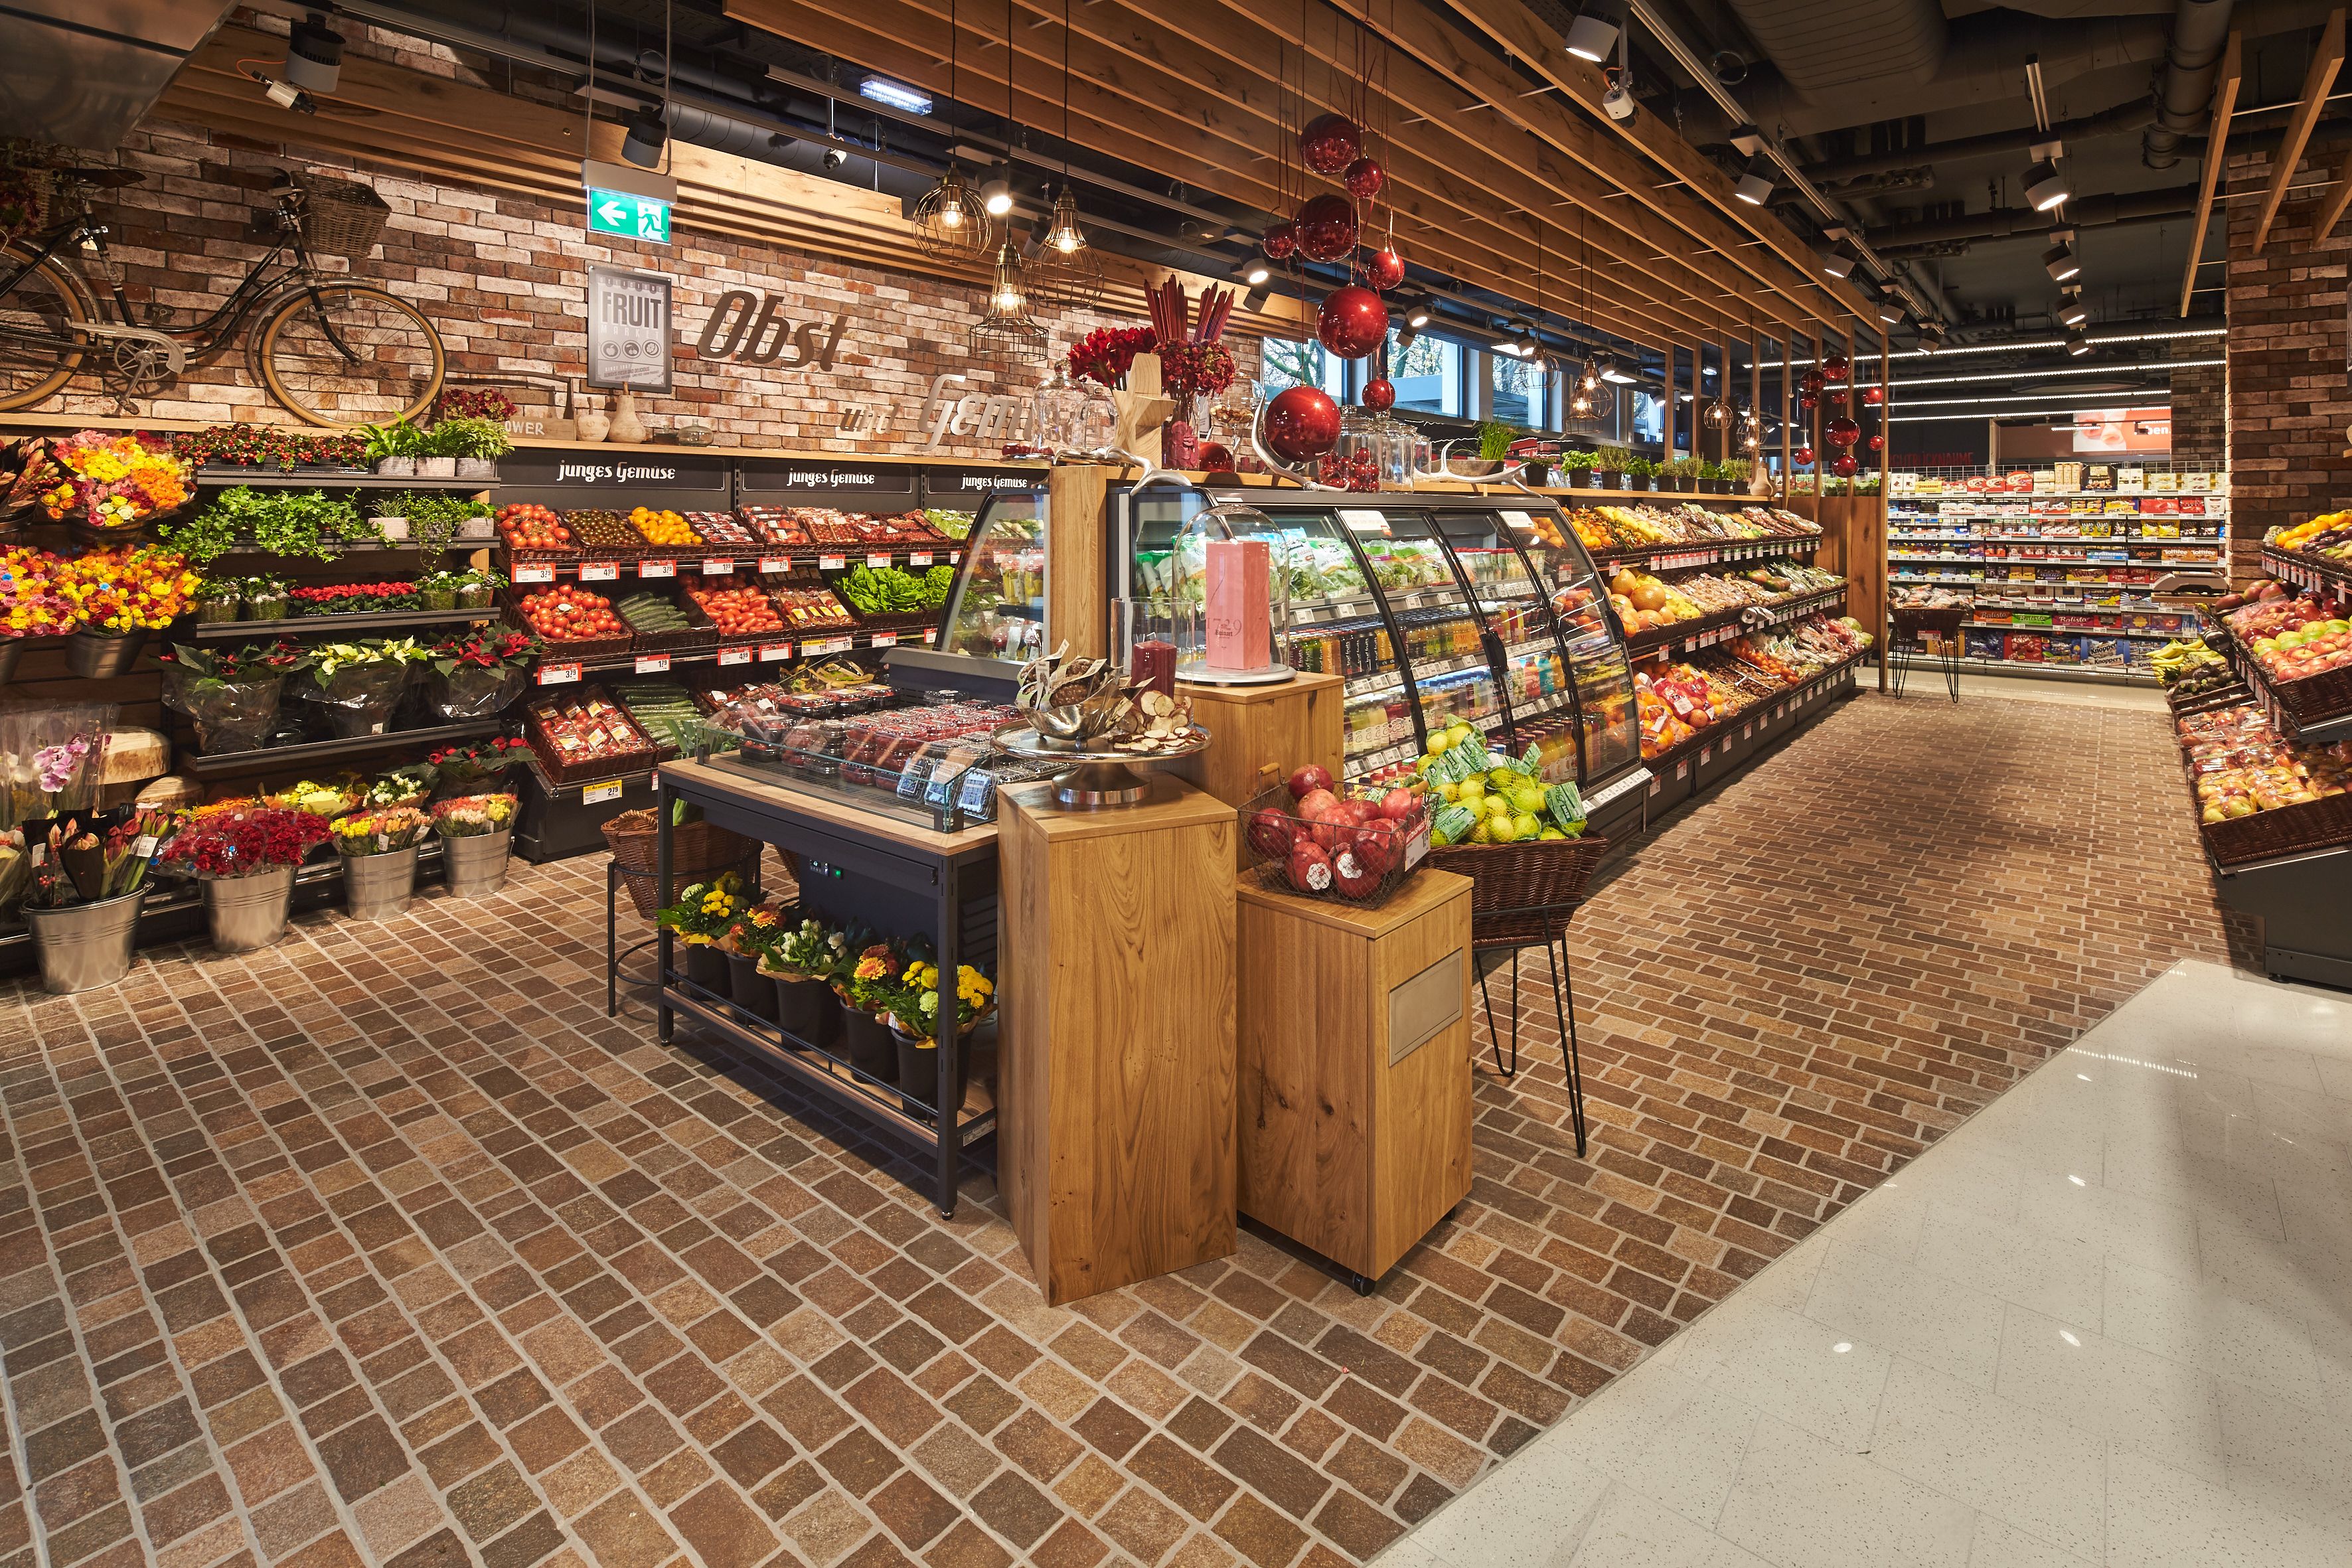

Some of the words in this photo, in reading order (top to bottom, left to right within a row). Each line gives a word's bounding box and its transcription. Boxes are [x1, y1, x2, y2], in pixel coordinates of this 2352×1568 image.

[602, 291, 661, 329] FRUIT
[601, 325, 659, 339] MARKET
[697, 290, 848, 372] Obst
[840, 403, 900, 435] und
[914, 374, 1036, 451] Gem
[505, 420, 545, 435] OWER
[556, 459, 612, 482] junges
[616, 462, 676, 482] Gemüse
[787, 467, 828, 487] junges
[830, 469, 875, 487] Gemüse
[961, 473, 992, 490] junges
[993, 474, 1028, 489] Gemüse
[1207, 617, 1242, 637] 1729
[2091, 643, 2116, 655] Knopper
[1562, 805, 1571, 819] REWE
